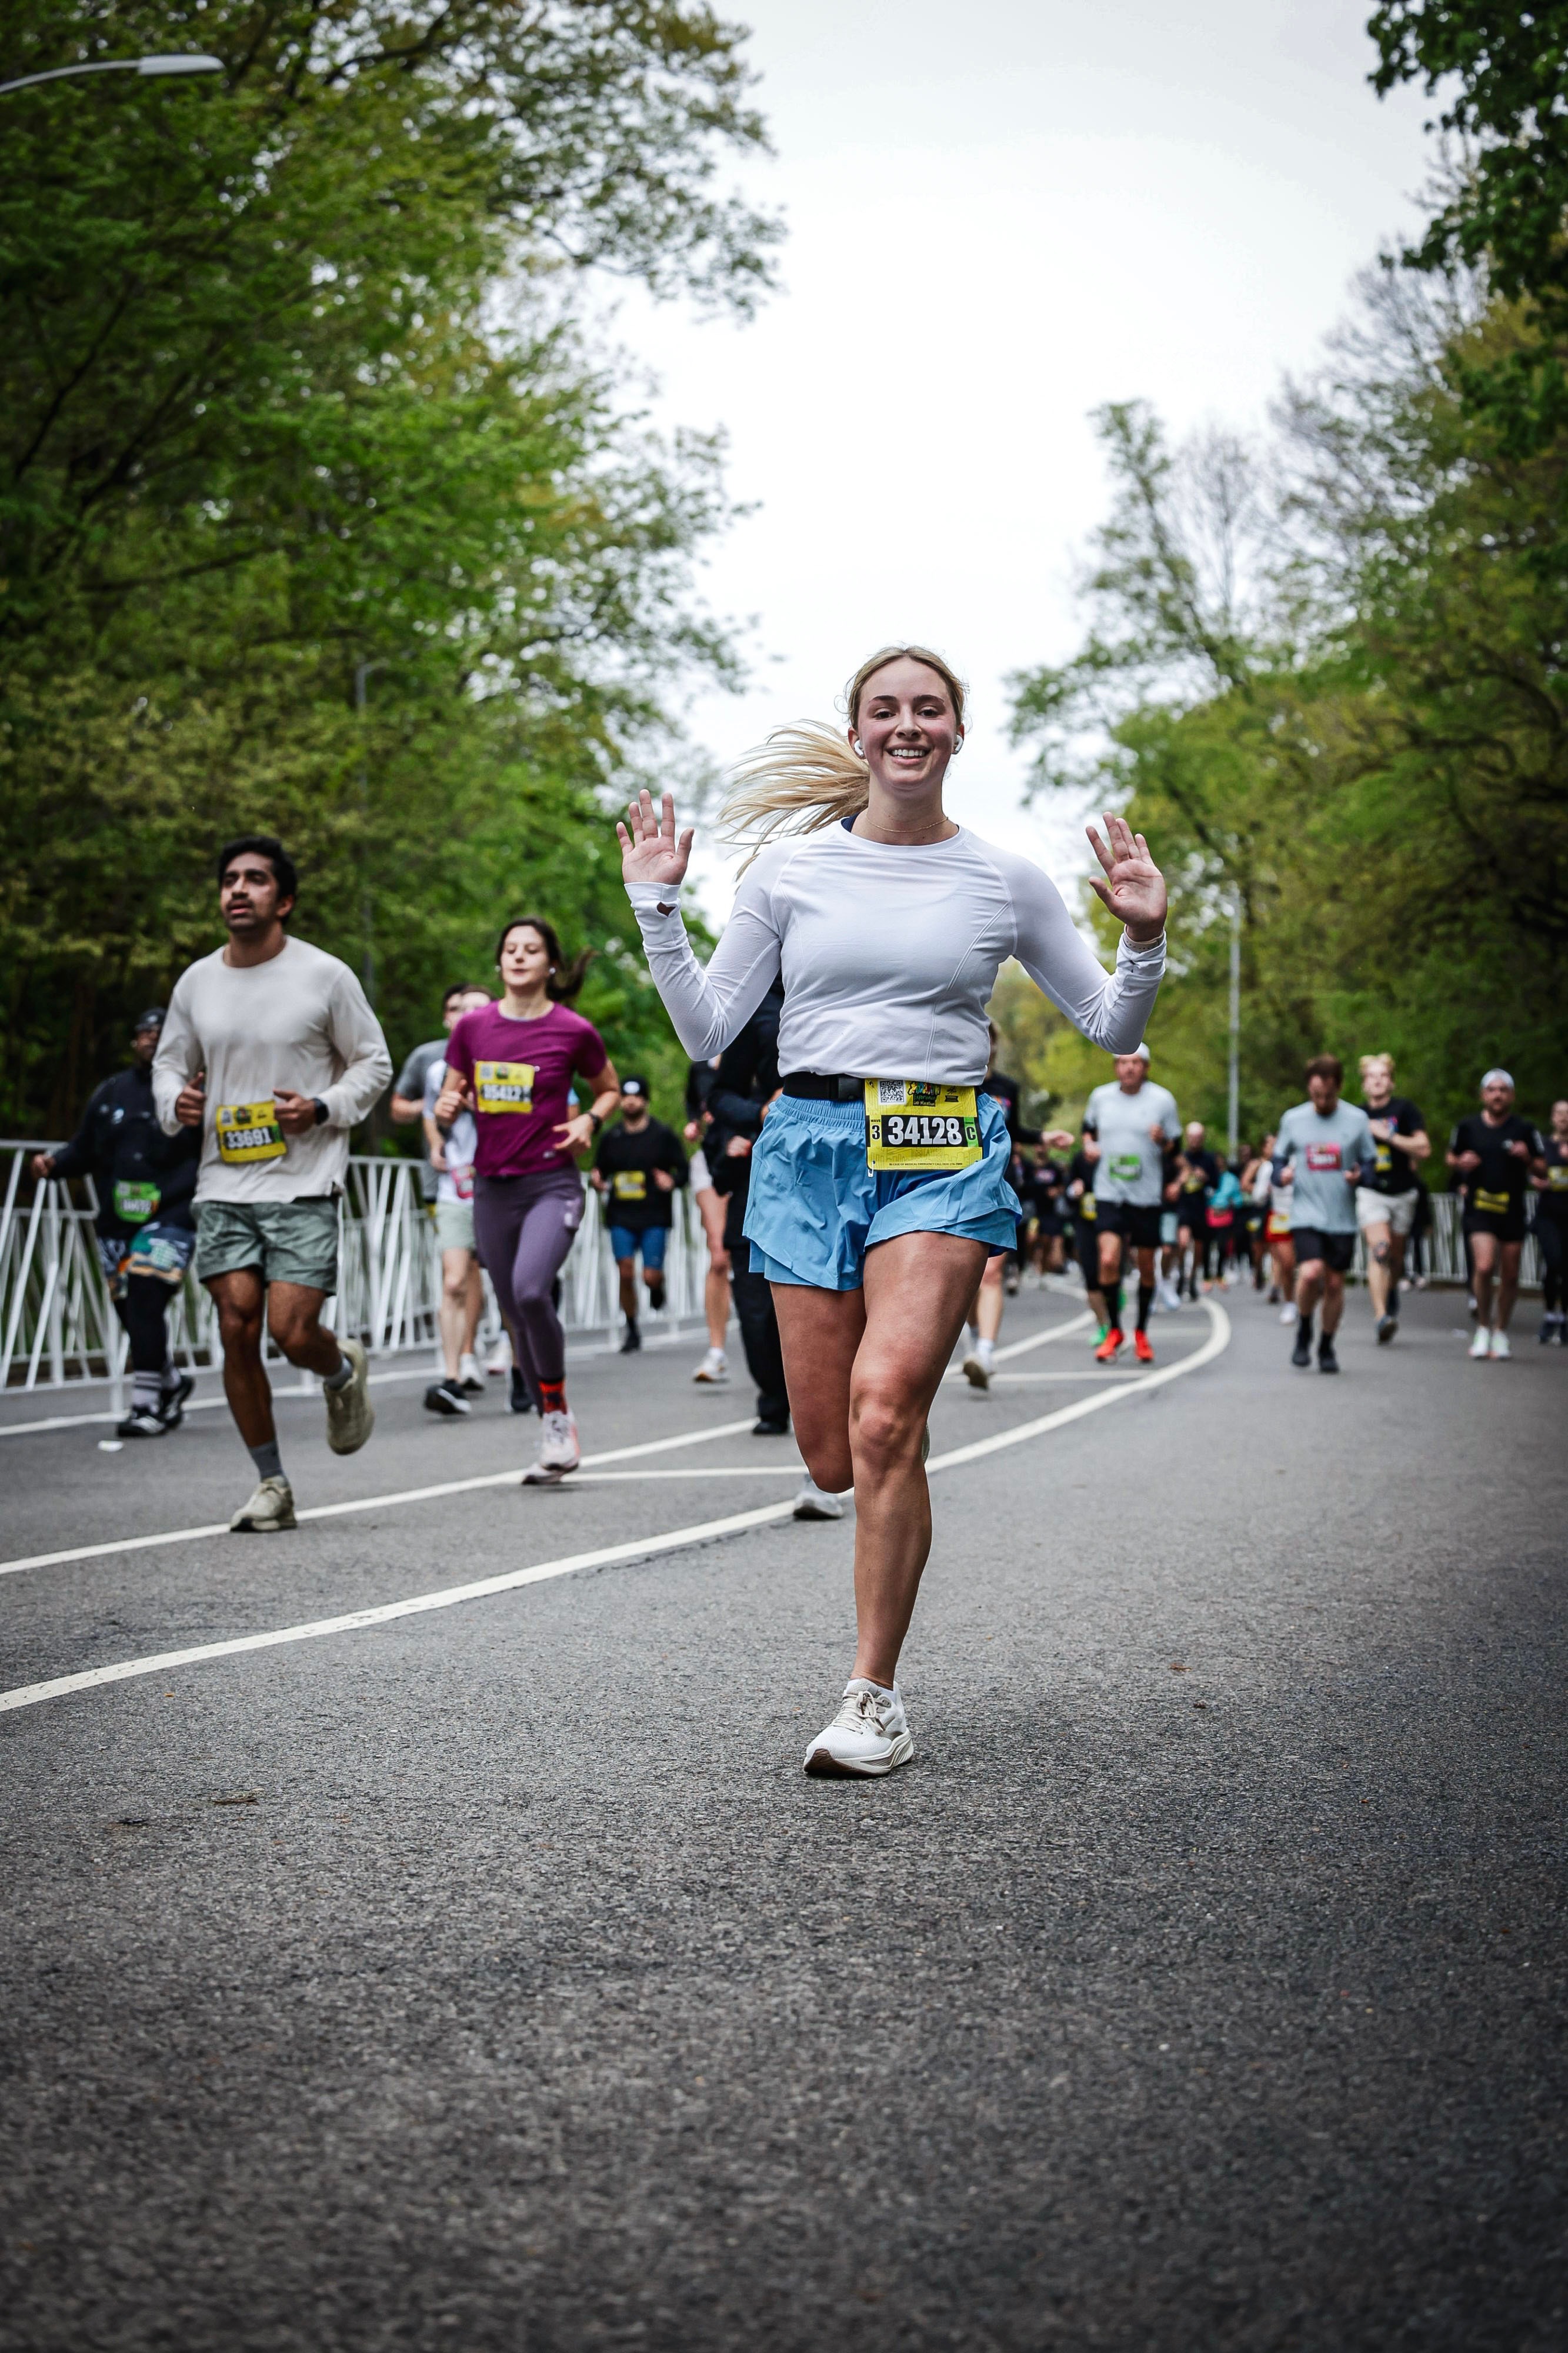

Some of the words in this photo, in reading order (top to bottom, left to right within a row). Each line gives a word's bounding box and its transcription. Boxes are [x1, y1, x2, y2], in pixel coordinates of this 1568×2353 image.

[872, 1125, 880, 1140] 3
[888, 1116, 962, 1145] 34128
[966, 1126, 976, 1141] C
